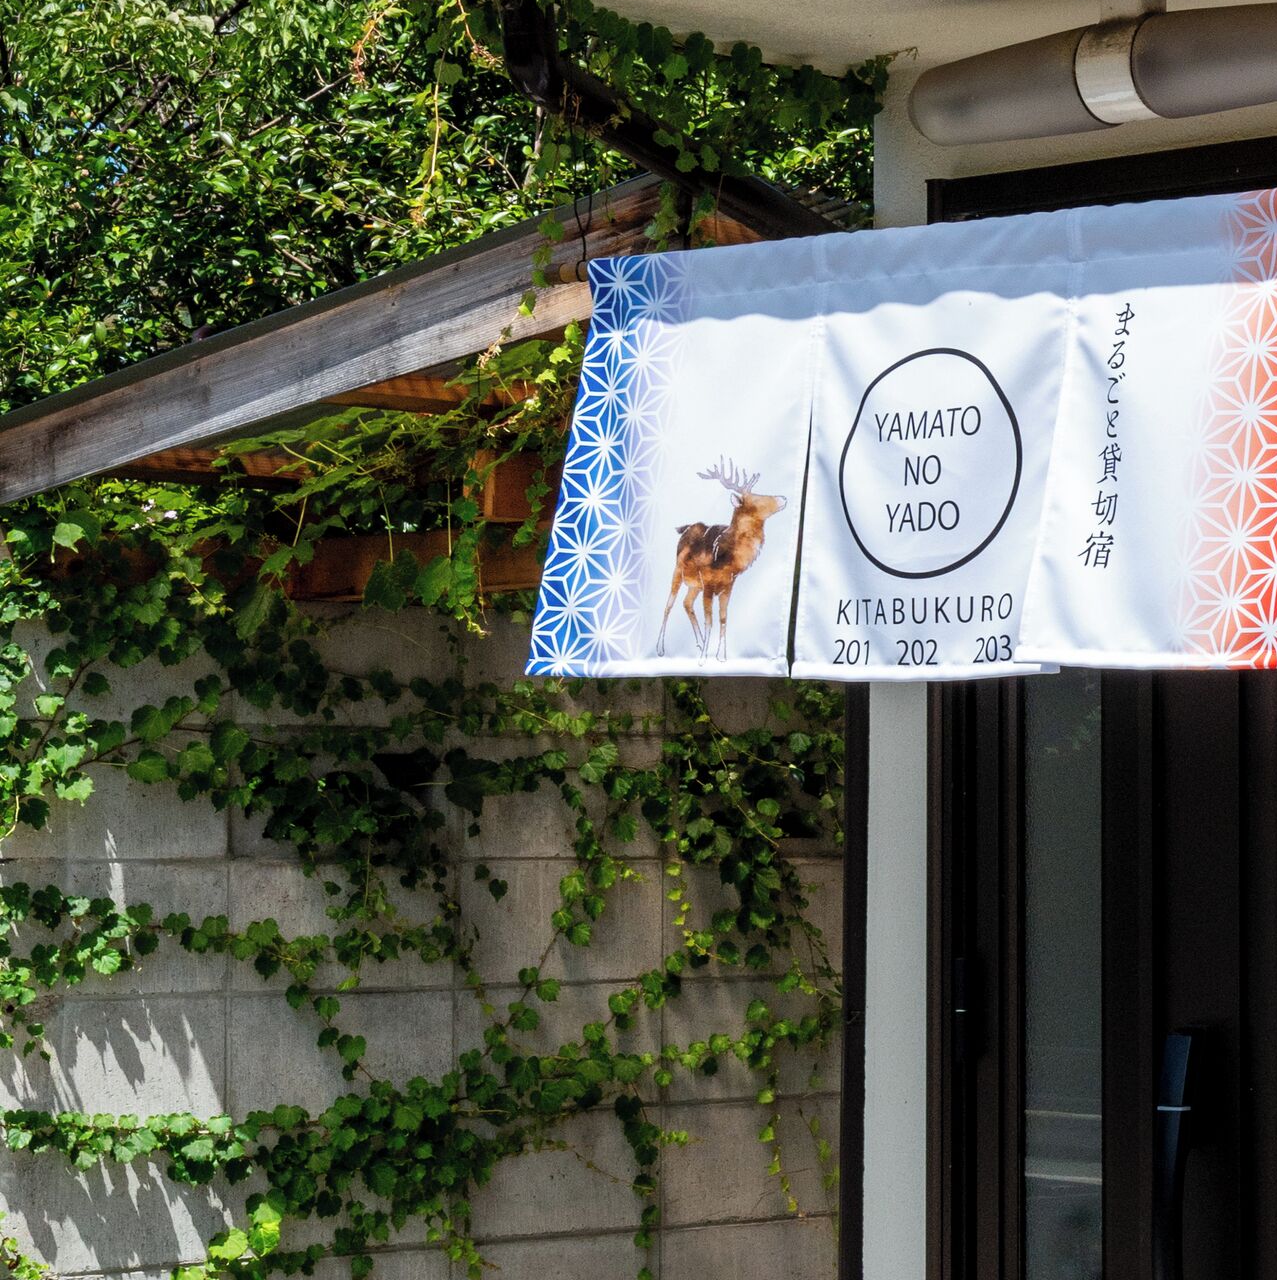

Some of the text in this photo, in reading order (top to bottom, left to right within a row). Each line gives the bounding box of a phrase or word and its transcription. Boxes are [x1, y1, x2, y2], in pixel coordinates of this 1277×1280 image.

[874, 405, 982, 442] YAMATO
[1077, 302, 1135, 568] まるごと貸切宿
[904, 454, 942, 486] NO
[886, 500, 960, 533] YADO
[836, 592, 1013, 625] KITABUKURO
[833, 634, 1013, 665] 201 202 203
